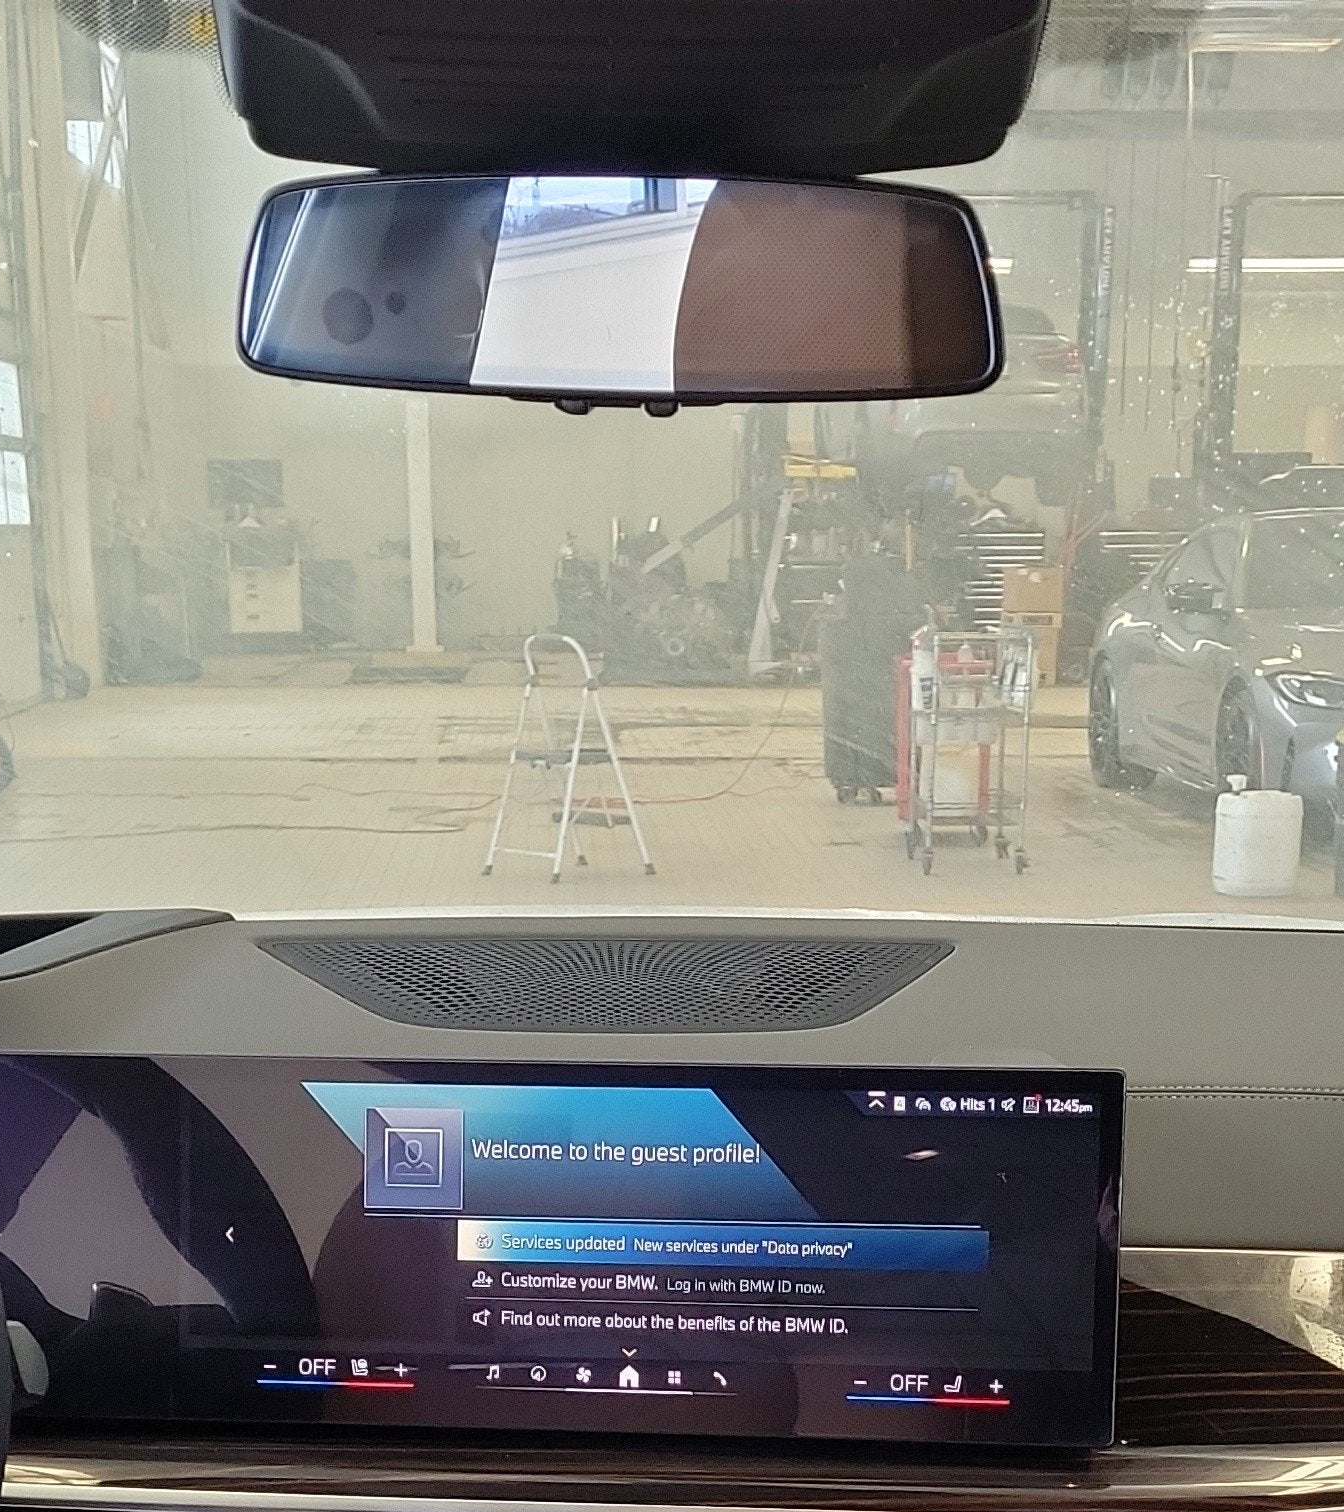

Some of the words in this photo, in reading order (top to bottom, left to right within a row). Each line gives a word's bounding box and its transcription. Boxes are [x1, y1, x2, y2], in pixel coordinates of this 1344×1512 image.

[960, 1097, 986, 1111] Hits
[988, 1098, 996, 1112] 1
[1045, 1098, 1093, 1114] 12:45pm
[471, 1139, 562, 1160] Welcome
[569, 1142, 587, 1160] to
[594, 1141, 625, 1161] the
[631, 1144, 687, 1166] guest
[693, 1143, 760, 1167] profile!
[501, 1234, 562, 1250] Services
[566, 1236, 626, 1253] updated
[634, 1238, 663, 1252] New
[665, 1239, 718, 1253] services
[721, 1240, 759, 1254] under
[762, 1240, 799, 1255] "Data
[801, 1241, 853, 1259] privacy"
[501, 1271, 577, 1289] Customize
[579, 1277, 613, 1292] your
[615, 1274, 659, 1291] BMW.
[666, 1277, 690, 1294] Log
[694, 1278, 706, 1291] in
[709, 1278, 736, 1293] with
[739, 1280, 774, 1293] BMW
[778, 1280, 792, 1293] ID
[795, 1284, 826, 1295] now.
[501, 1310, 533, 1326] Find
[536, 1313, 561, 1327] out
[563, 1314, 601, 1328] more
[605, 1313, 647, 1329] about
[650, 1314, 674, 1330] the
[678, 1314, 736, 1331] benefits
[739, 1316, 755, 1332] of
[757, 1317, 781, 1333] the
[785, 1317, 824, 1334] BMW
[829, 1318, 849, 1334] ID.
[298, 1357, 337, 1376] OFF
[890, 1373, 929, 1392] OFF
